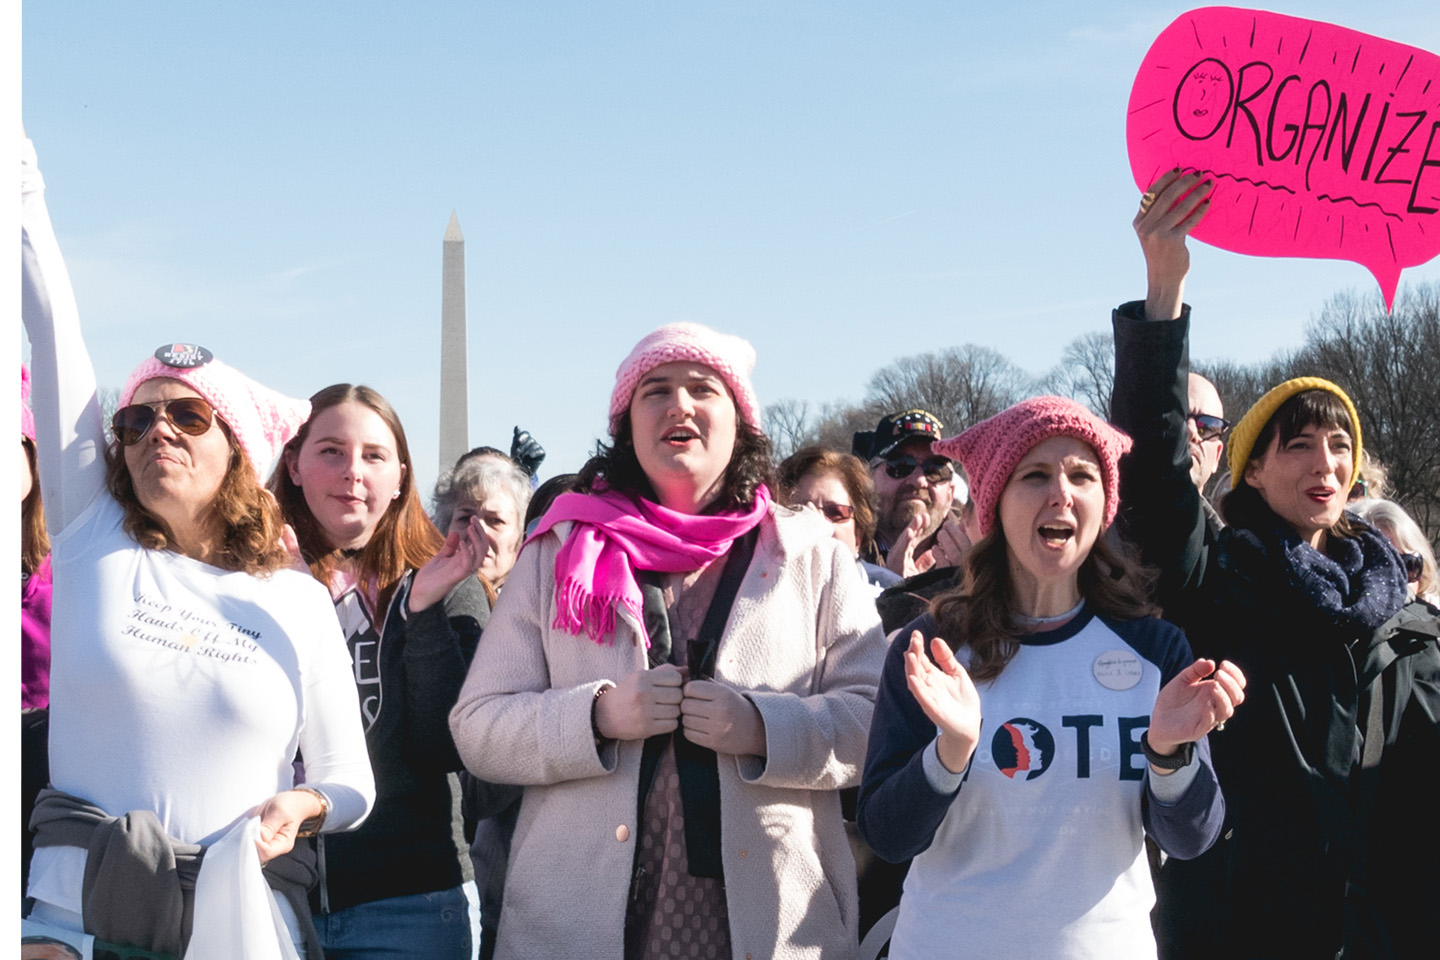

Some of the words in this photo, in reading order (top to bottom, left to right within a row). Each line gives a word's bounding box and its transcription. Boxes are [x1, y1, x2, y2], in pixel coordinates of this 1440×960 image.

[1173, 57, 1440, 214] ORGANIZE
[121, 625, 190, 653] Human
[226, 622, 262, 640] Tiny
[963, 714, 1152, 782] OTE
